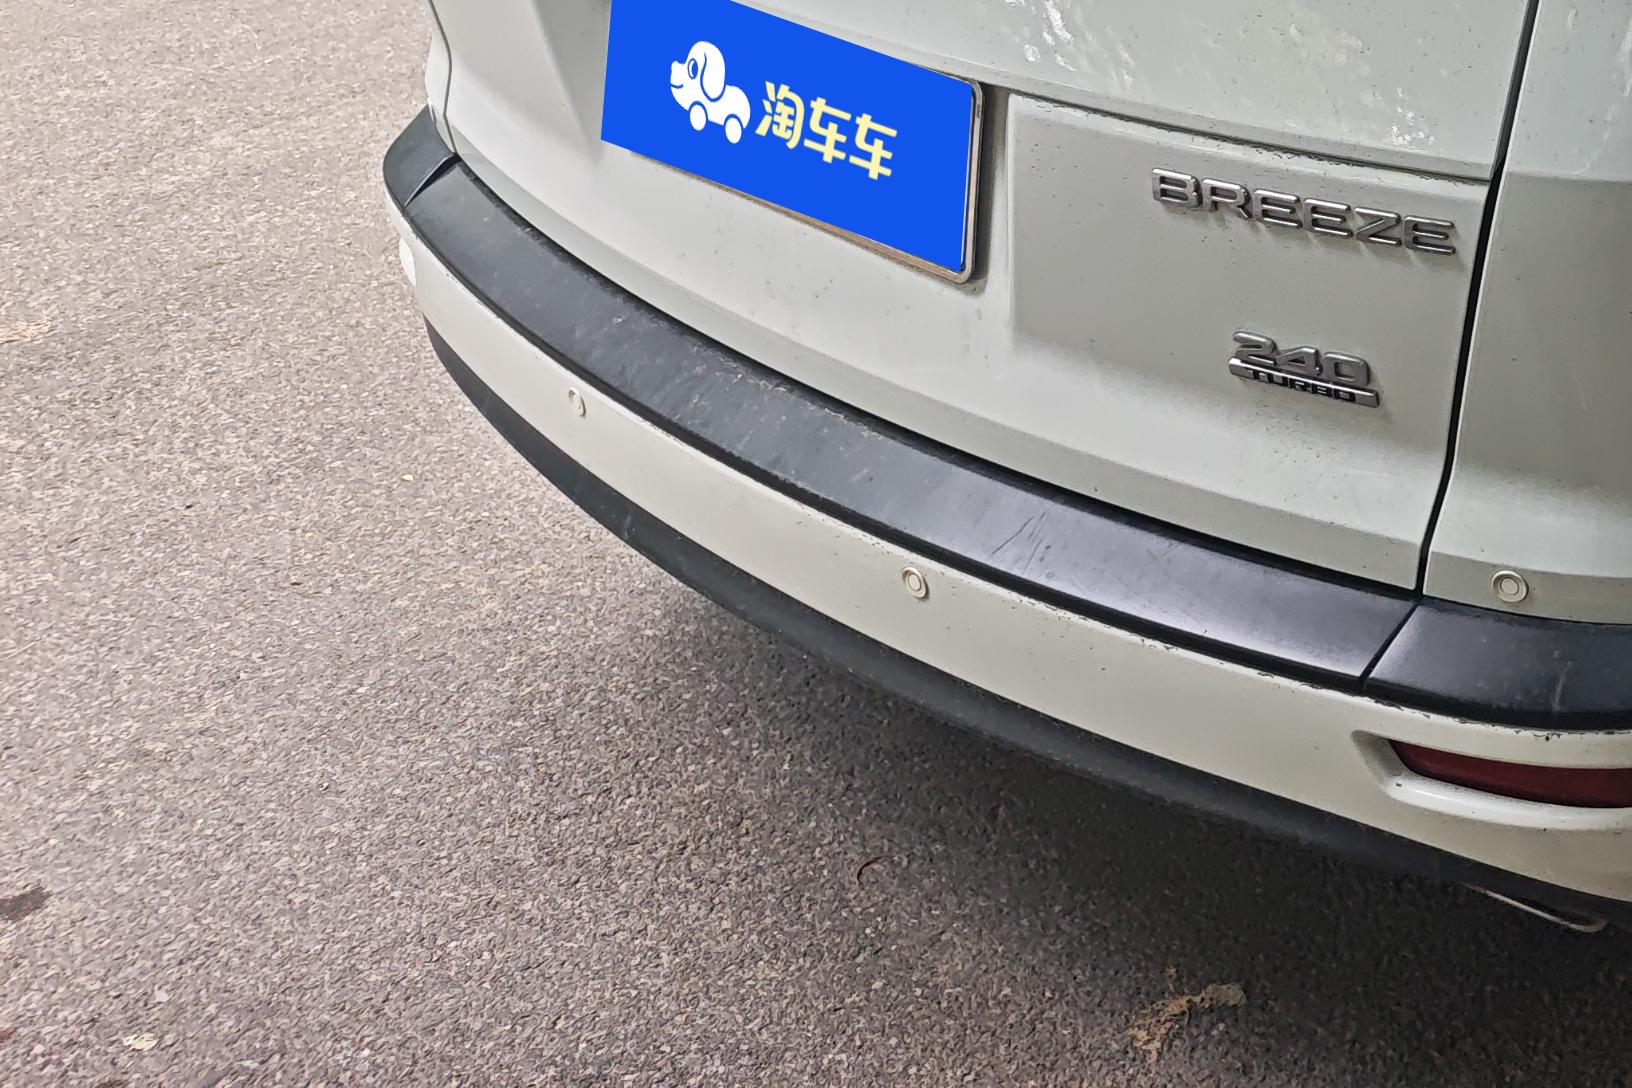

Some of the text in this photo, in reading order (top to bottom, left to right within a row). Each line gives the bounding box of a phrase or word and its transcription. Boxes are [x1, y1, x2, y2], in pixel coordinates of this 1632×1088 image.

[1151, 167, 1457, 256] BREEZE
[1232, 330, 1371, 386] 240
[1248, 366, 1358, 404] TURBO
